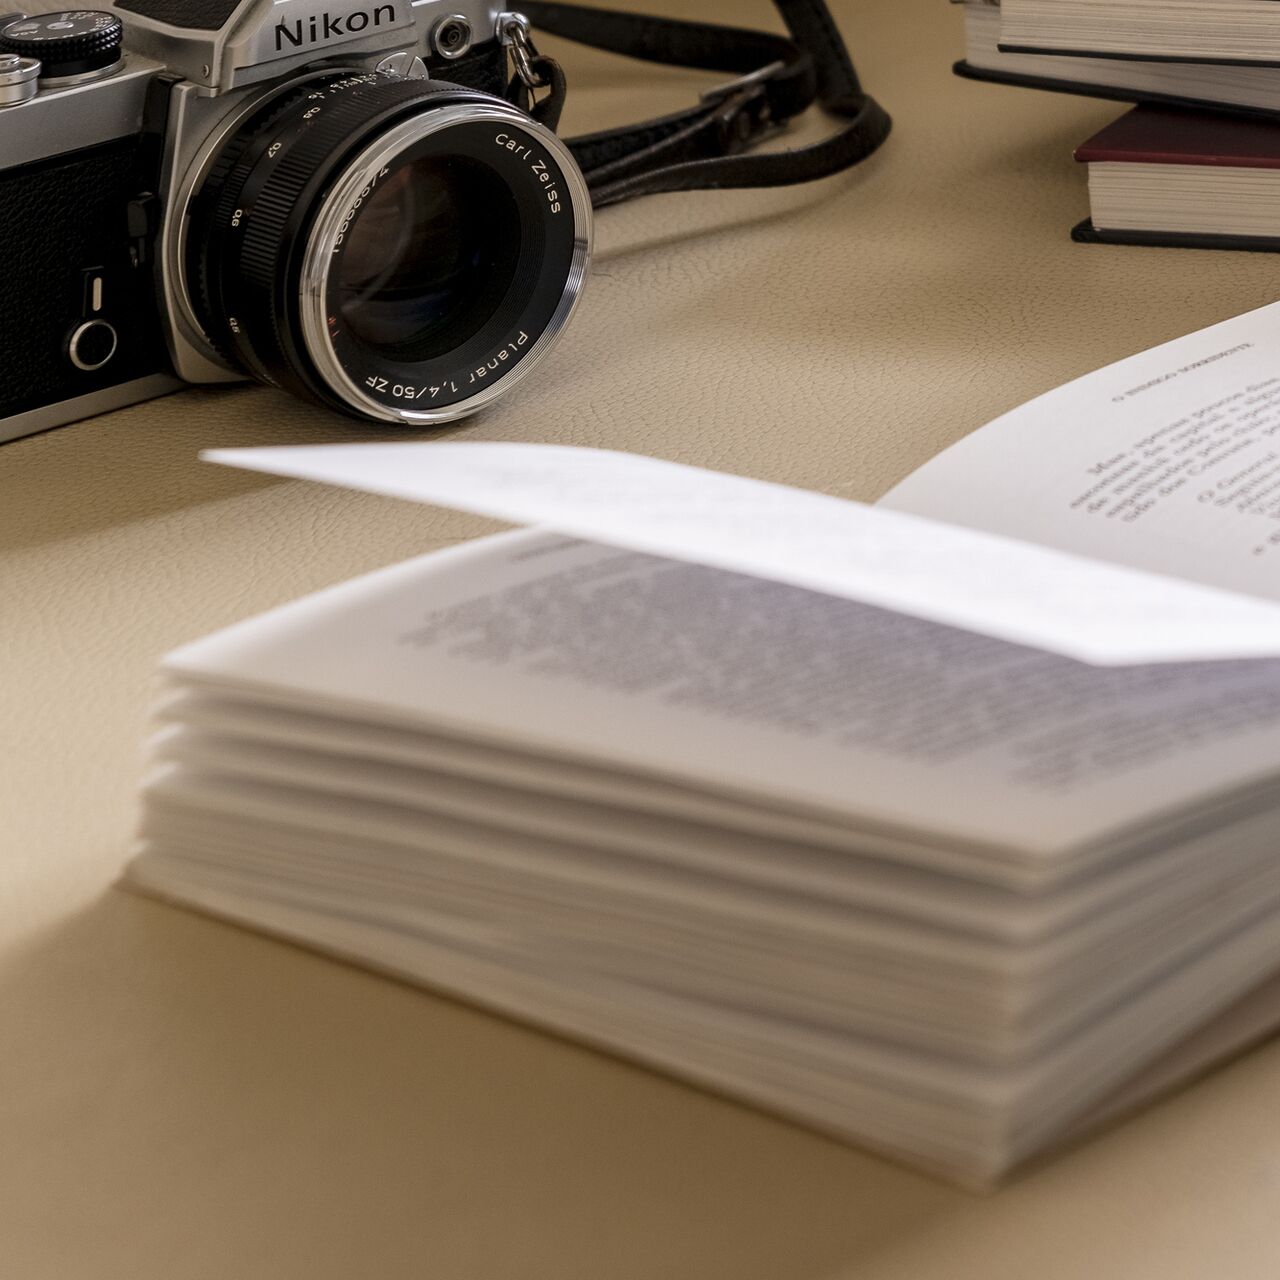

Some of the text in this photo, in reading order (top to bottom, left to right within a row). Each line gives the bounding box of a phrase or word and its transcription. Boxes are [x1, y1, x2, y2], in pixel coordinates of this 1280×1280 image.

[275, 5, 395, 51] Nikon
[495, 133, 561, 214] Carl Zeiss
[469, 331, 528, 384] Planar
[366, 375, 388, 392] ZF
